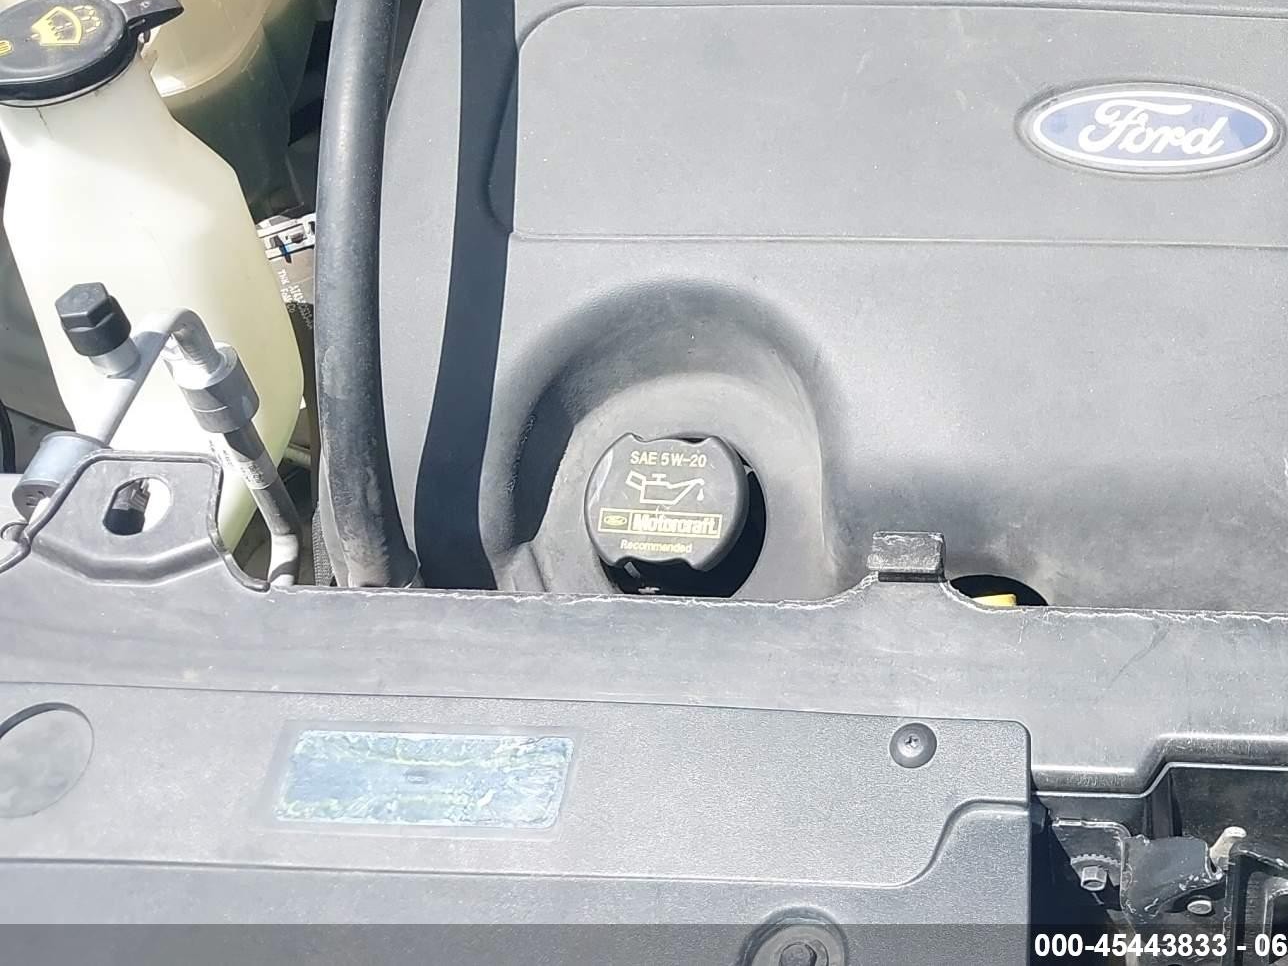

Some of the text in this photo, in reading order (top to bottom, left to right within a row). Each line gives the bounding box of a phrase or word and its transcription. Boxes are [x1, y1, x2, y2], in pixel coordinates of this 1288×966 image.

[1078, 99, 1229, 155] Ford
[630, 450, 707, 468] SAE 5W-20
[631, 513, 718, 535] Motorcraft
[620, 539, 693, 554] Recommended
